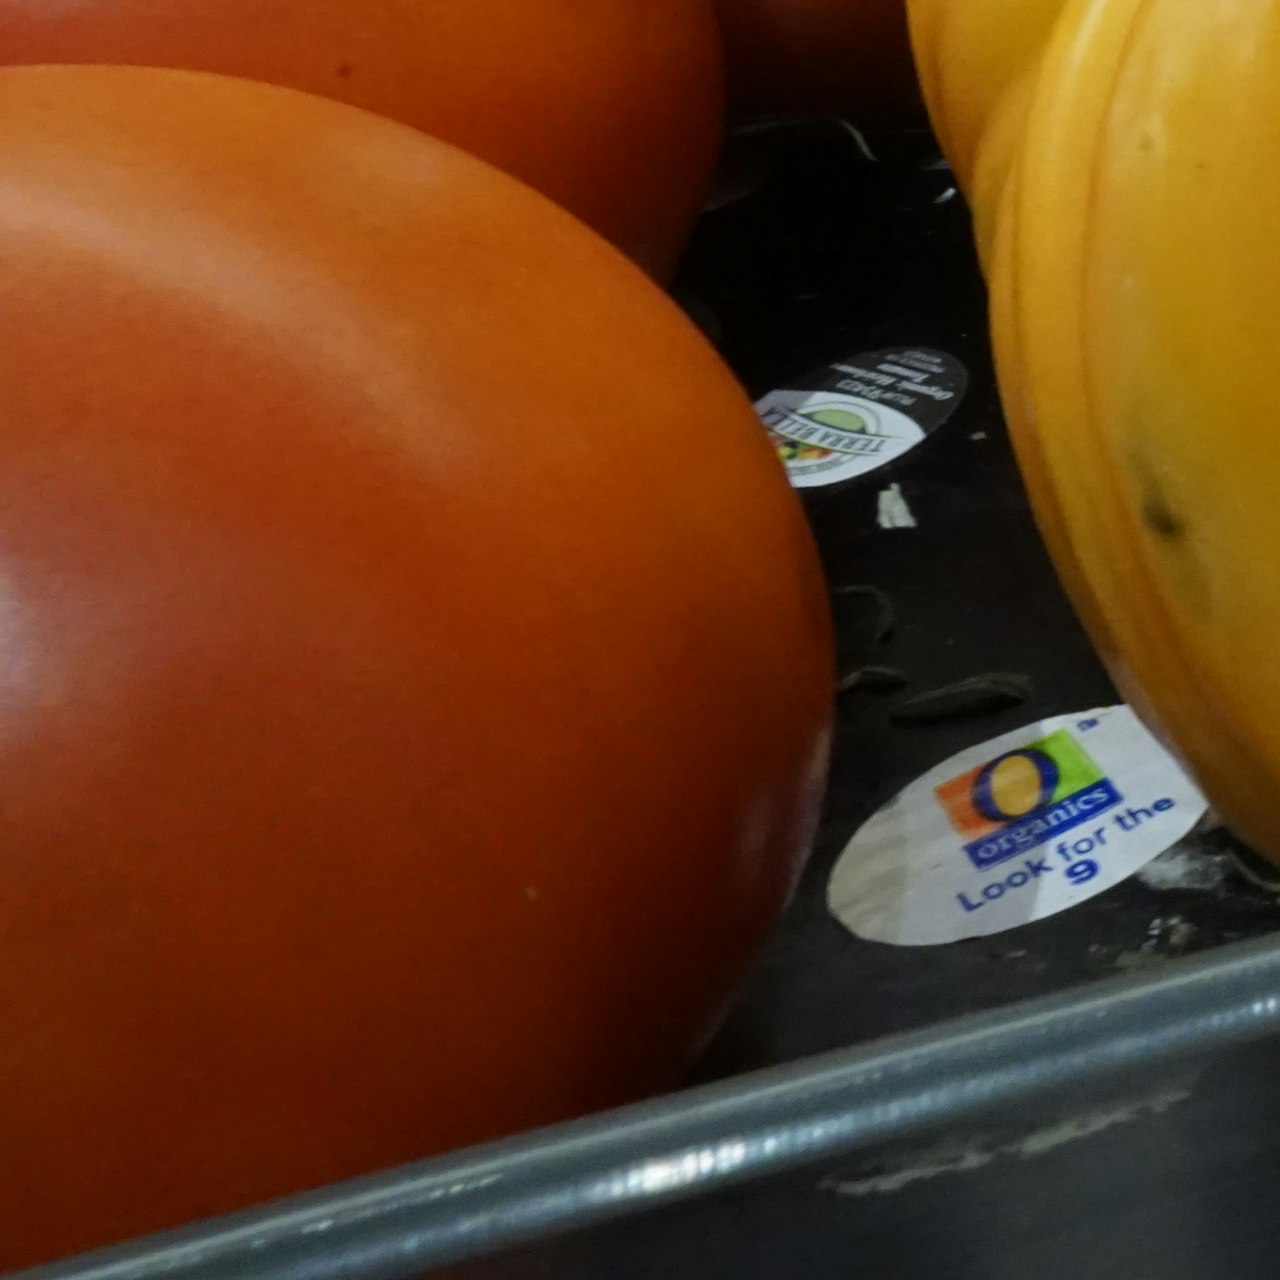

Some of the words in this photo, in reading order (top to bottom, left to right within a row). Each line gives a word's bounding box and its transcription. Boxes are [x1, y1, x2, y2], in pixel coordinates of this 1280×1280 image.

[956, 859, 1051, 913] Look
[1057, 825, 1107, 862] for
[1112, 797, 1176, 833] the
[978, 787, 1109, 861] organics
[1064, 858, 1099, 886] 9
